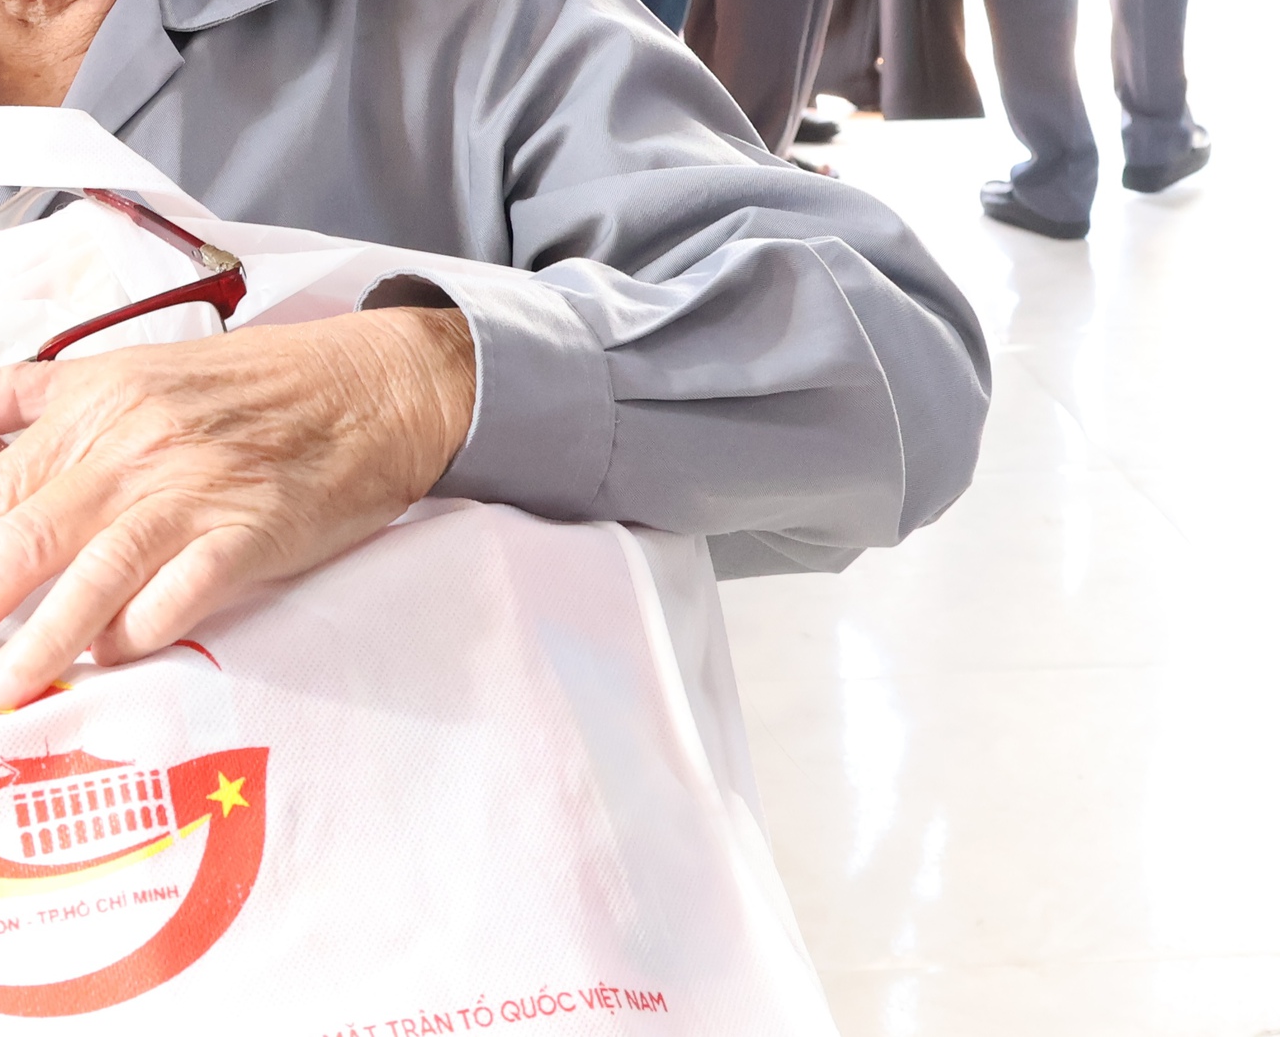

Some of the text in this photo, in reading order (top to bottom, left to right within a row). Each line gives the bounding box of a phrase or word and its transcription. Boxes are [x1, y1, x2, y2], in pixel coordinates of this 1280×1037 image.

[132, 885, 180, 905] MINH
[500, 985, 577, 1023] QUỐC
[578, 981, 622, 1015] VIỆT
[623, 990, 668, 1013] NAM
